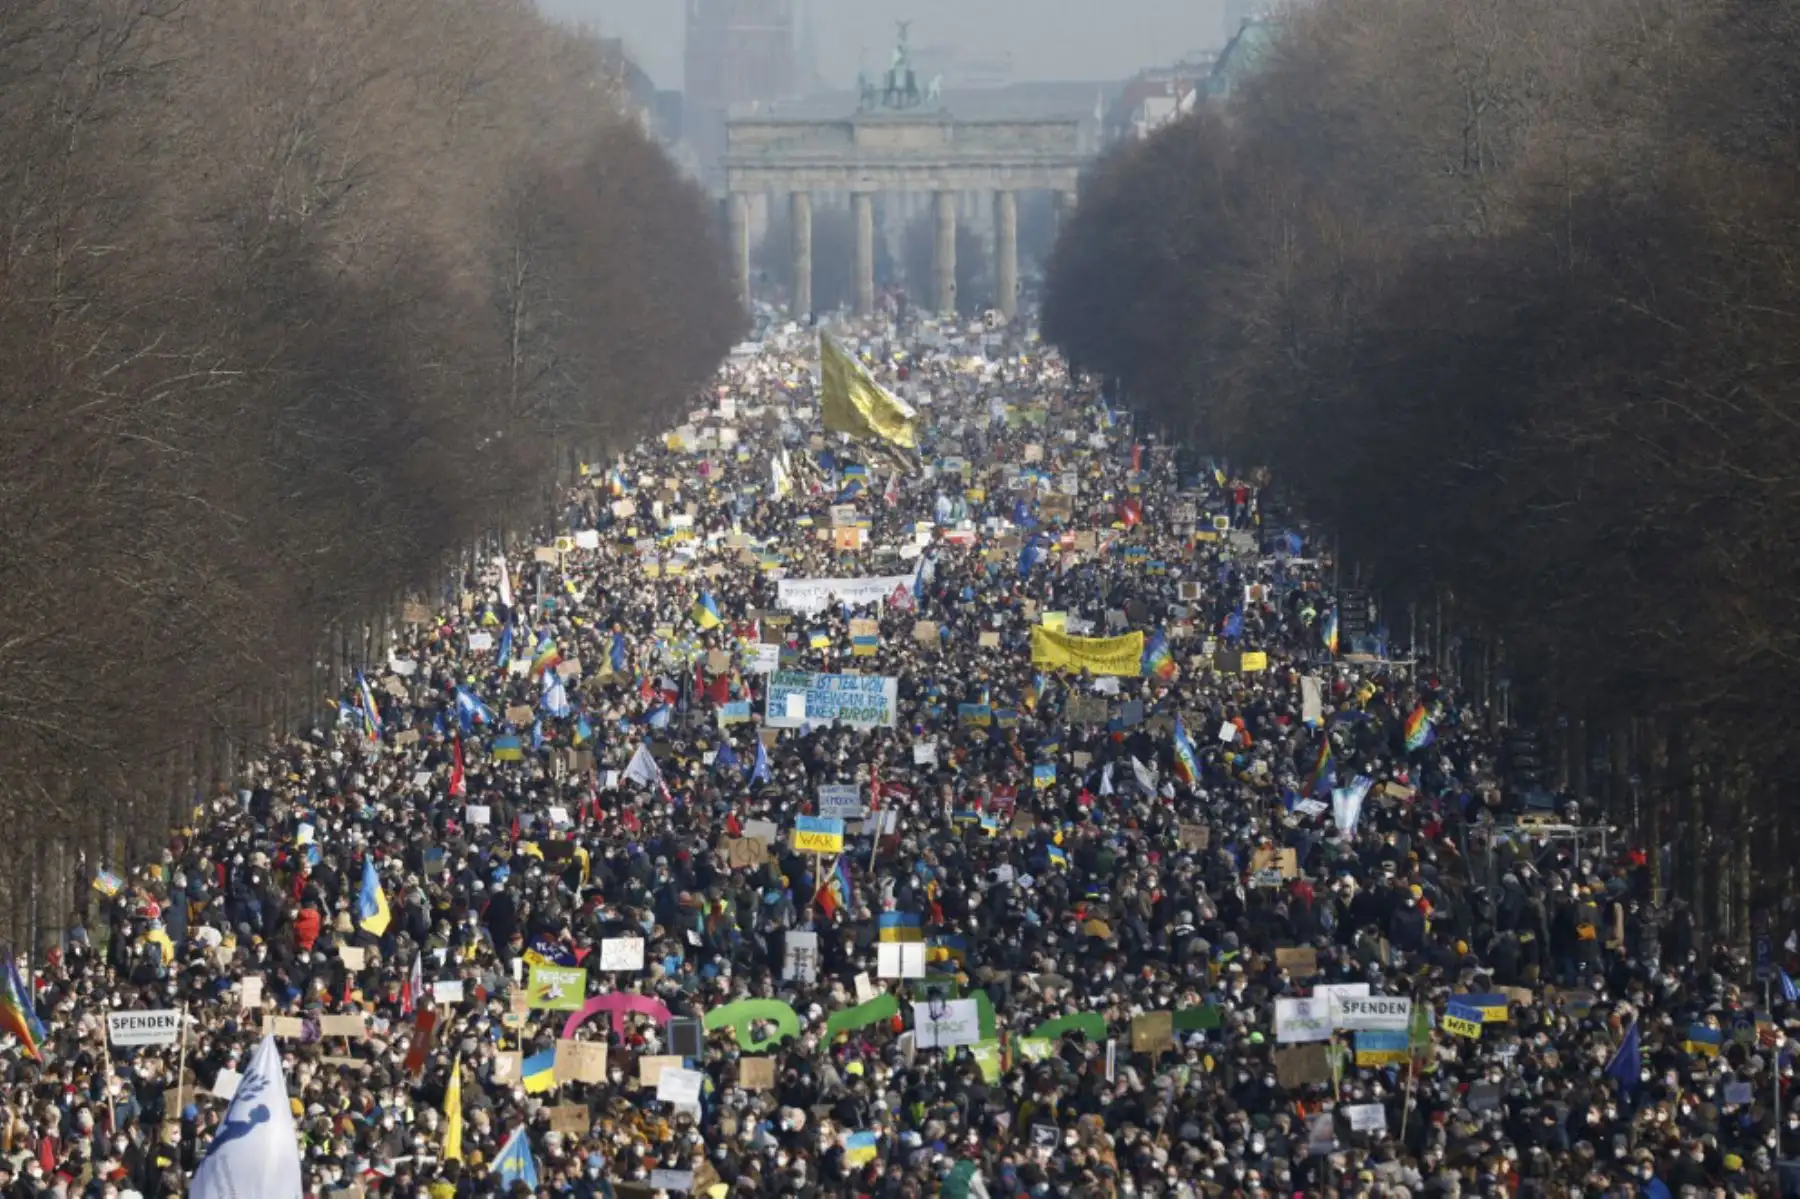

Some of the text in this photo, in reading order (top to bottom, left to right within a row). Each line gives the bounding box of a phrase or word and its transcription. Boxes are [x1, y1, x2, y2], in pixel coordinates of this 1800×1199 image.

[817, 674, 832, 689] IST
[861, 674, 885, 692] VON
[797, 688, 864, 706] EMEINSAM
[799, 832, 833, 849] WAR
[1342, 1001, 1407, 1014] SPENDEN
[111, 1015, 175, 1029] SPENDEN
[1448, 1017, 1475, 1035] WAR
